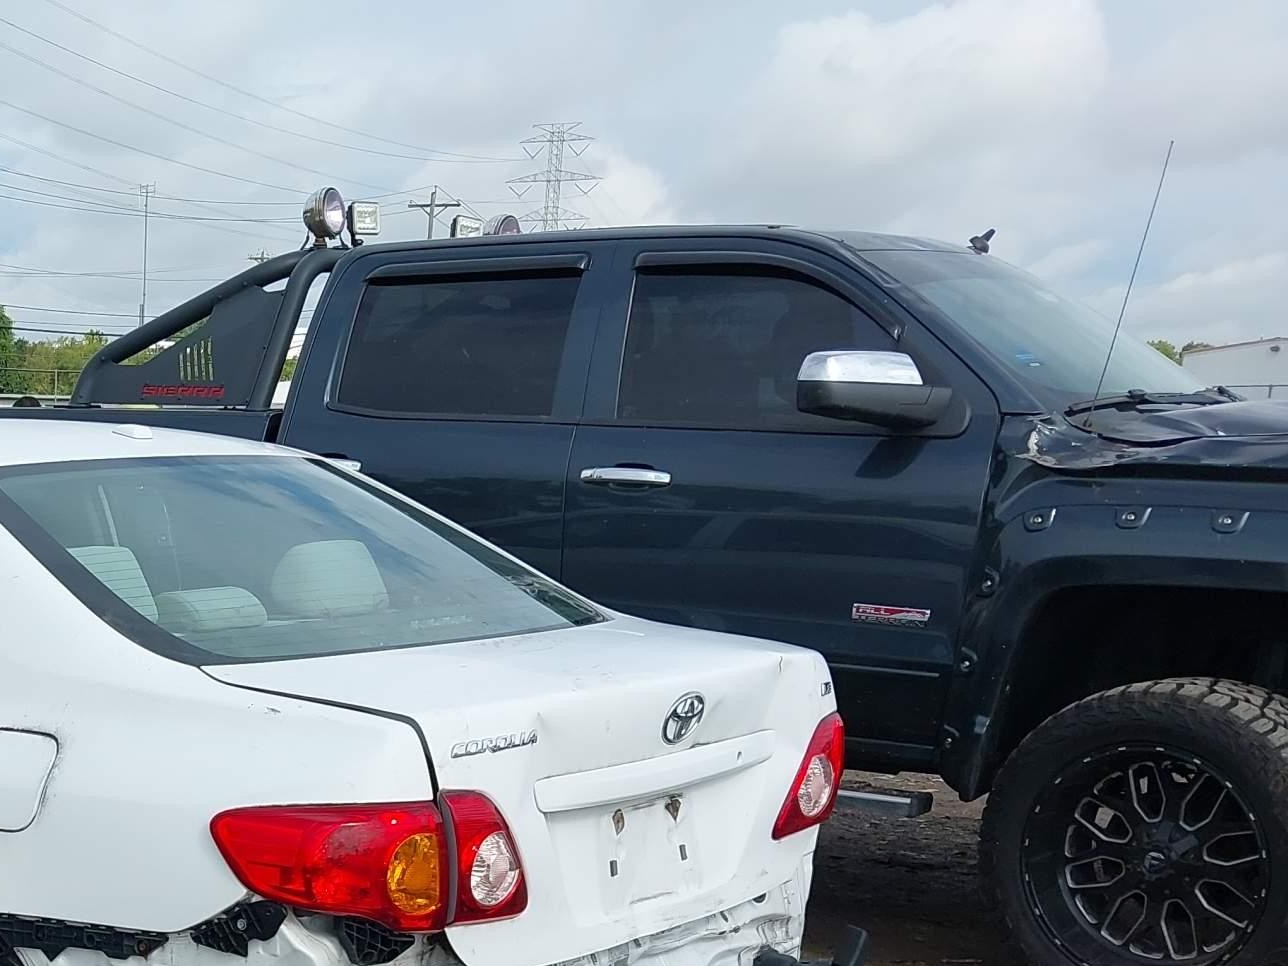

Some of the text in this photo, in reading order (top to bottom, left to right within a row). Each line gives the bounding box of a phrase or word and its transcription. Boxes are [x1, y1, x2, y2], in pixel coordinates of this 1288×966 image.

[142, 386, 224, 397] SIERRA
[858, 606, 891, 616] ALL
[450, 728, 538, 759] COROLLA
